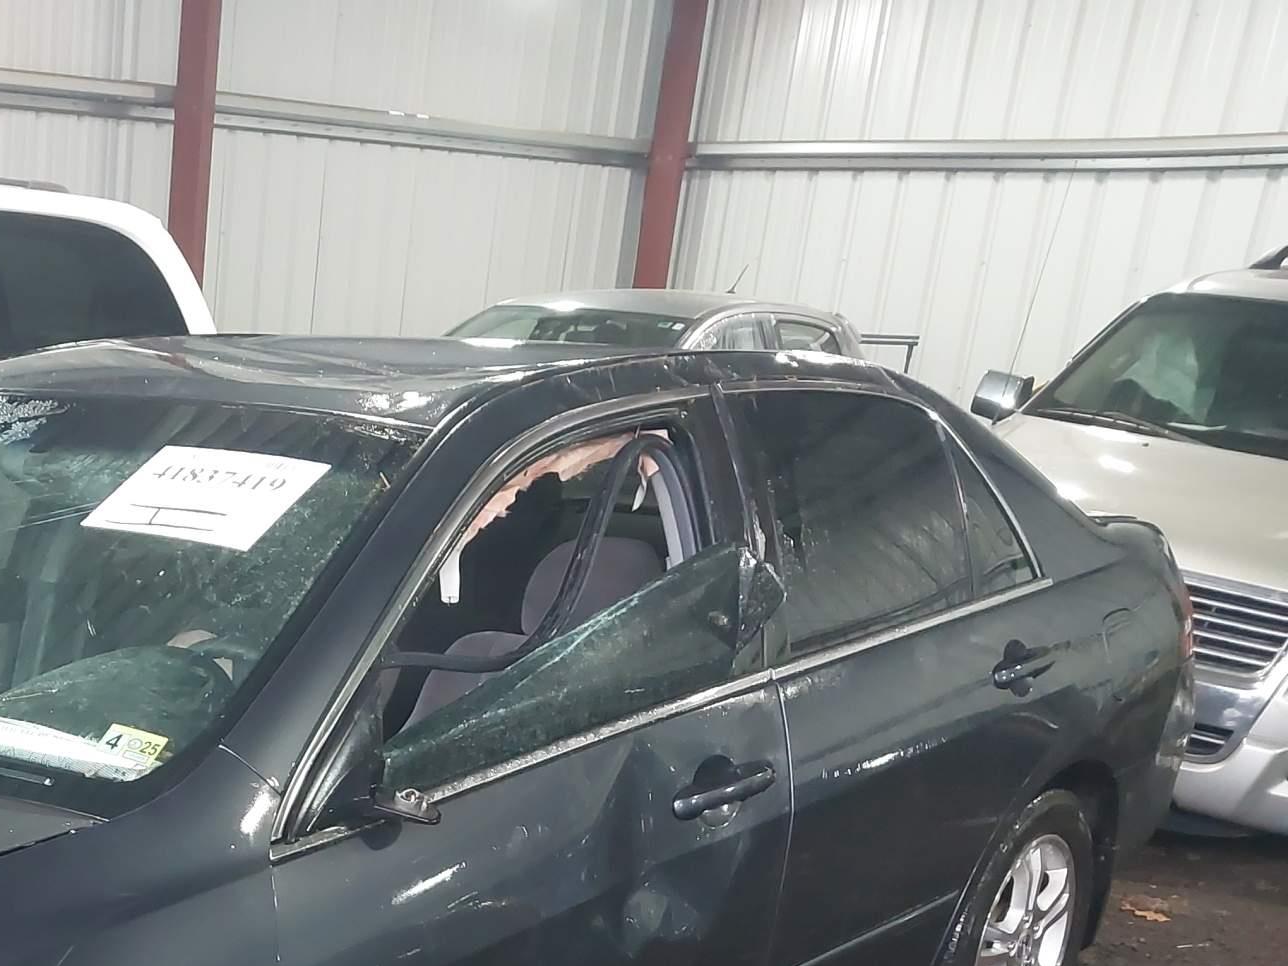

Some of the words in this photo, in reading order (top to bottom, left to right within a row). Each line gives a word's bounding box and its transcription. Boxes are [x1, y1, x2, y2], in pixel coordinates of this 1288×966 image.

[152, 464, 287, 491] 41837419
[105, 734, 123, 750] 4
[139, 741, 162, 756] 25
